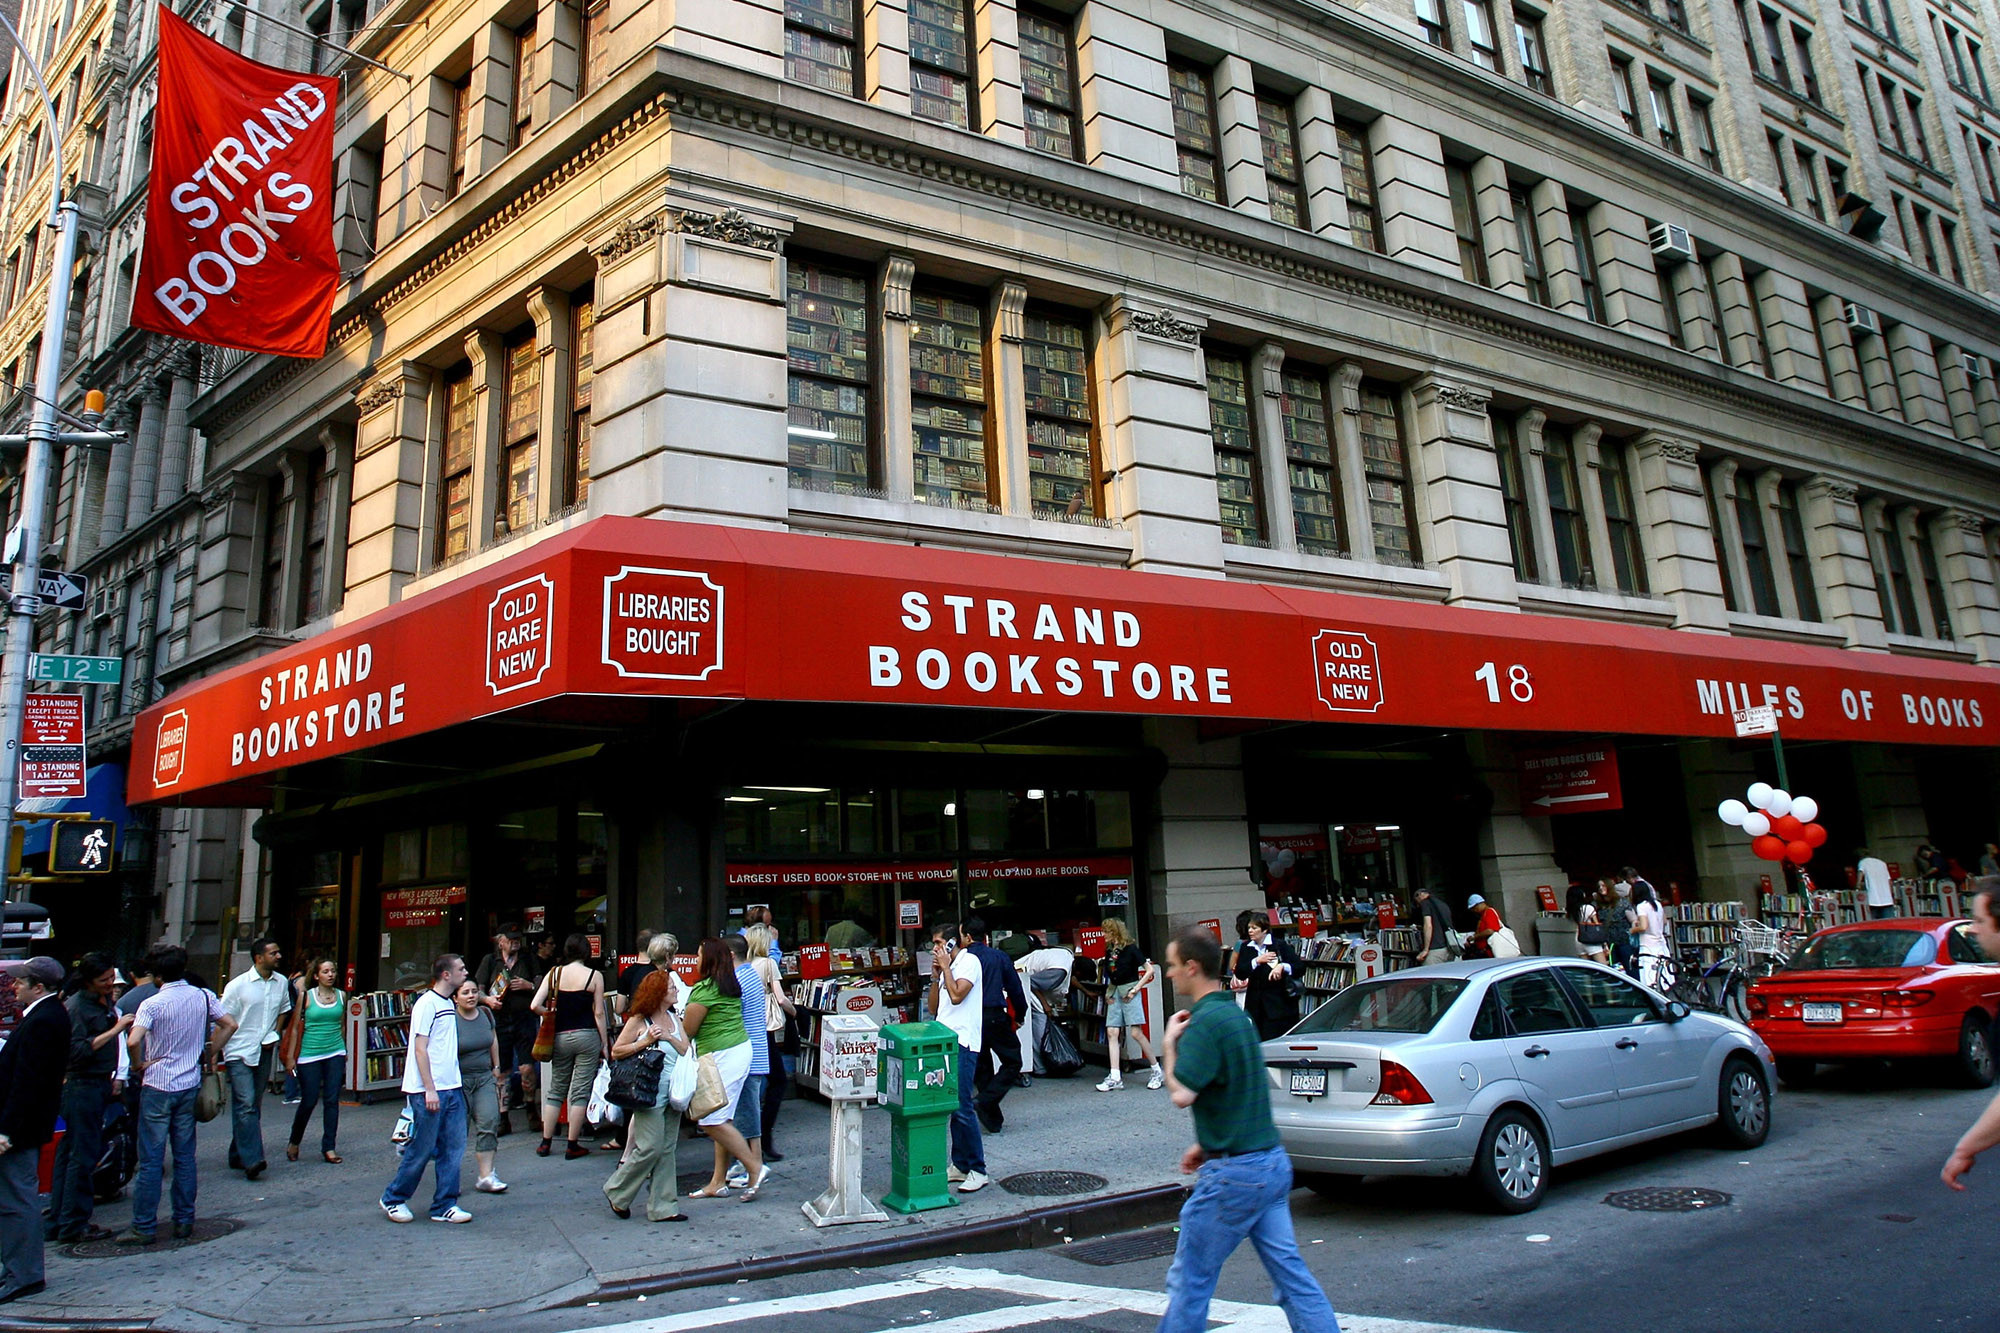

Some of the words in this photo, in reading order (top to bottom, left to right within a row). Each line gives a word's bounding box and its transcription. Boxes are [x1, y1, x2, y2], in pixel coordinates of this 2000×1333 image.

[170, 82, 327, 230] STRAND
[154, 172, 313, 327] BOOKS
[503, 592, 537, 621] OLD
[618, 592, 710, 623] LIBRARIES
[901, 590, 1141, 648] STRAND
[497, 618, 541, 652] RARE
[626, 629, 700, 656] BOUGHT
[1330, 641, 1362, 659] OLD
[39, 658, 54, 678] E
[63, 659, 91, 680] 12
[98, 661, 115, 672] ST
[499, 647, 536, 678] NEW
[1325, 662, 1372, 681] RARE
[259, 643, 373, 711] STRAND
[869, 645, 1232, 703] BOOKSTORE
[1332, 683, 1369, 701] NEW
[26, 699, 38, 707] NO
[40, 699, 79, 707] STANDING
[1840, 688, 1874, 721] OF
[1902, 694, 1984, 728] BOOKS
[32, 720, 49, 728] 7AM
[57, 720, 74, 728] 7PM
[231, 683, 406, 767] BOOKSTORE
[1734, 712, 1746, 722] NO
[159, 726, 183, 749] LIBRARIES
[158, 750, 180, 772] BOUGHT
[1586, 751, 1605, 761] HERE
[41, 763, 80, 771] STANDING
[1280, 839, 1315, 848] SPECIALS
[729, 873, 778, 883] LARGEST
[783, 872, 811, 883] USED
[847, 872, 880, 882] STORE
[882, 872, 892, 881] IN
[895, 871, 914, 880] THE
[918, 869, 953, 879] WORLD
[993, 868, 1011, 877] OLD
[1015, 867, 1033, 876] AND
[1035, 866, 1057, 876] RARE
[1061, 865, 1090, 875] BOOKS
[417, 889, 443, 898] LARGEST
[429, 896, 449, 905] BOOKS
[389, 911, 404, 919] OPEN
[802, 945, 827, 955] SPECIAL
[620, 956, 637, 964] SPECI
[848, 1000, 872, 1008] STRAND
[836, 1044, 877, 1055] Annex
[835, 1068, 877, 1079] CLAES
[922, 1166, 934, 1175] 20
